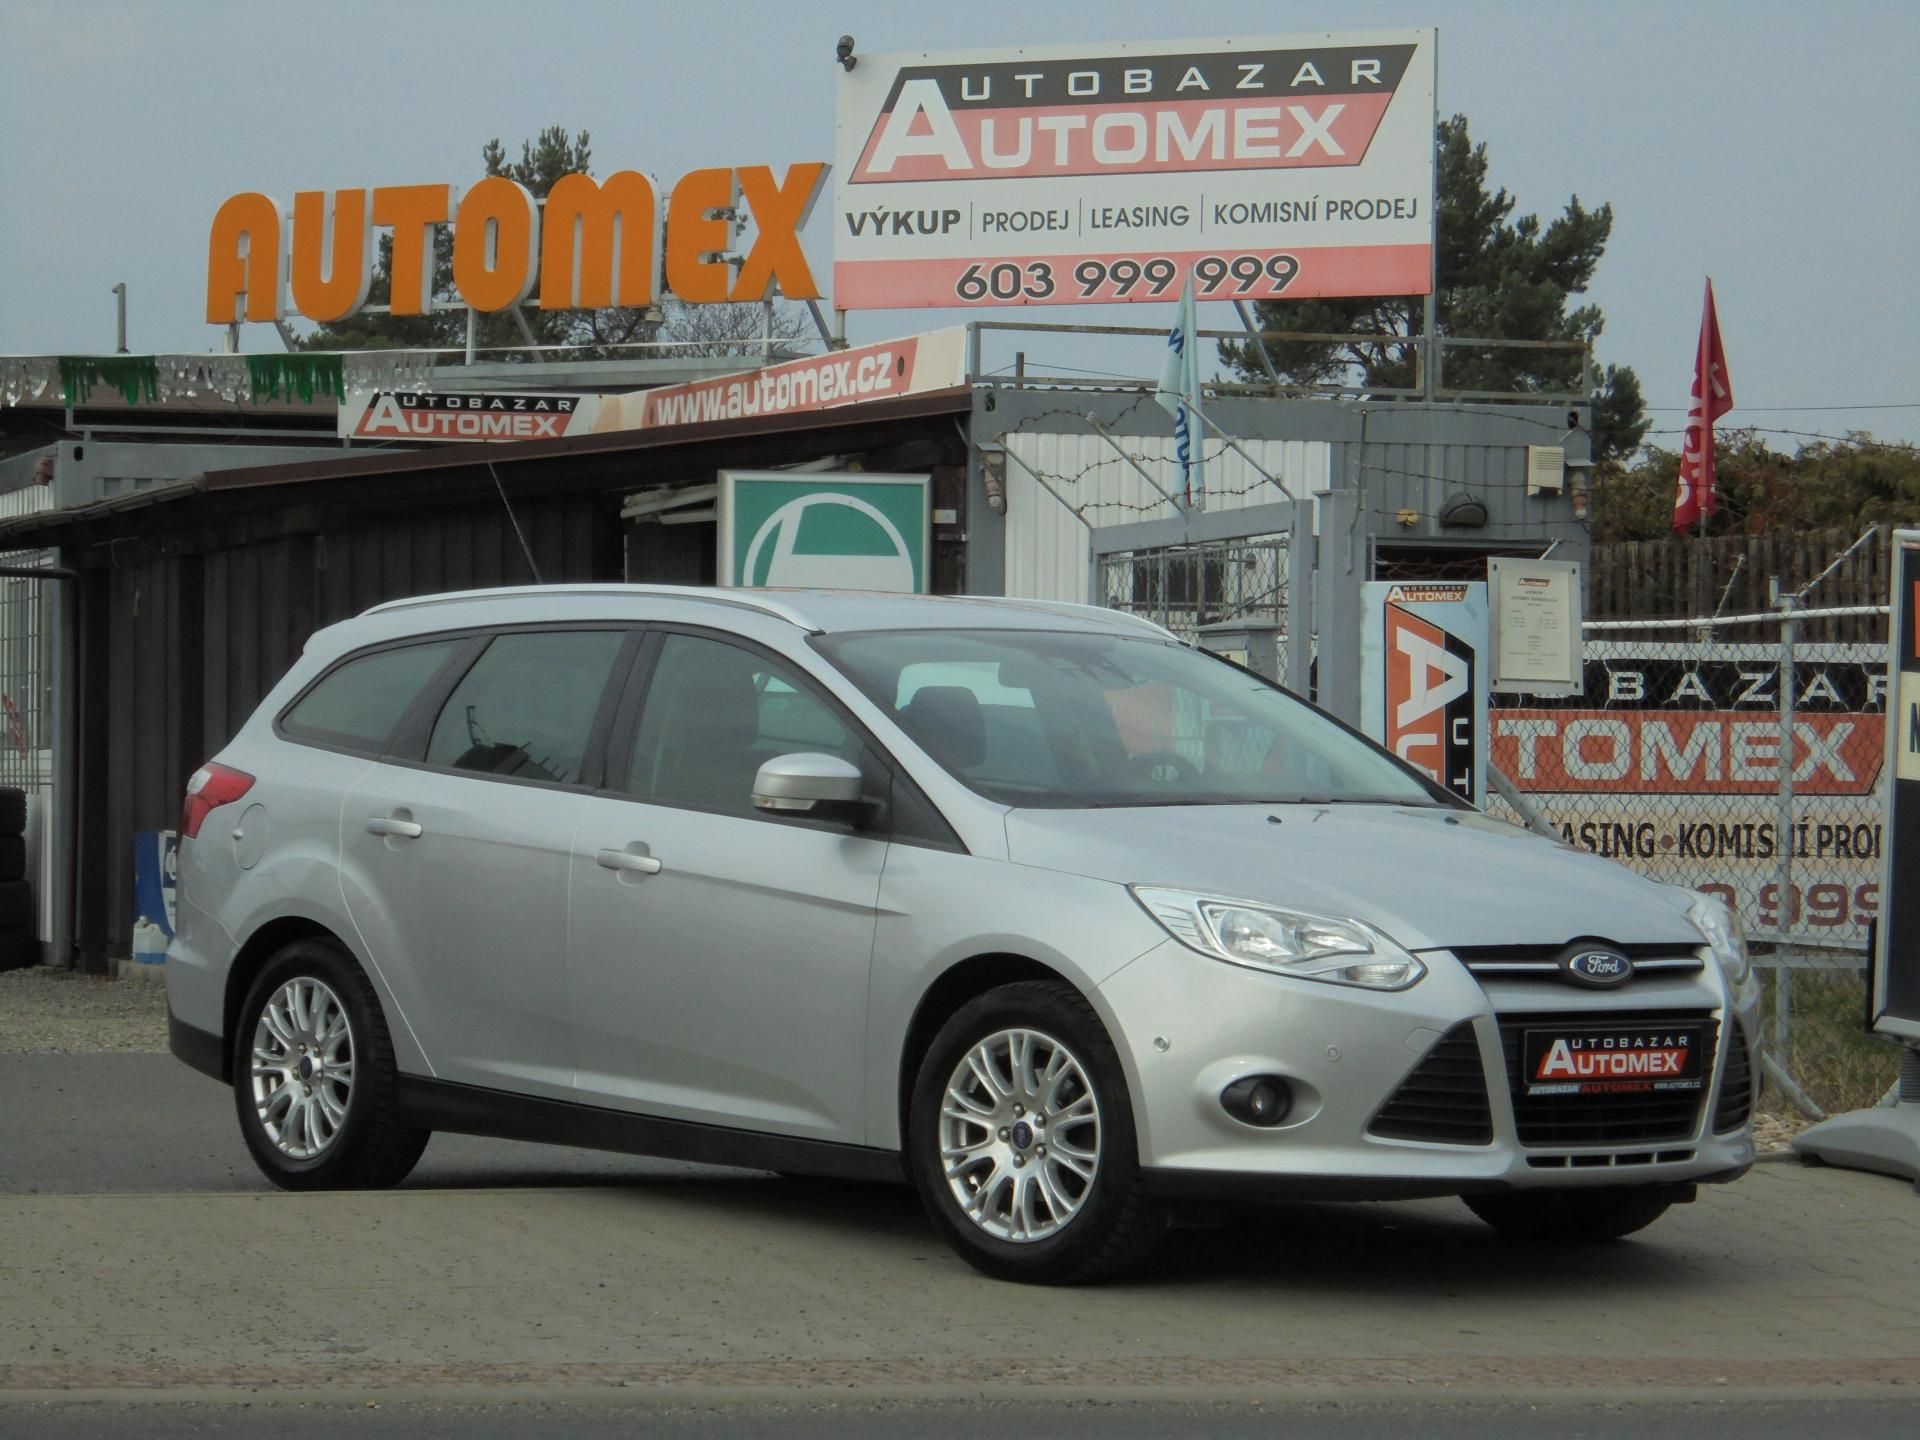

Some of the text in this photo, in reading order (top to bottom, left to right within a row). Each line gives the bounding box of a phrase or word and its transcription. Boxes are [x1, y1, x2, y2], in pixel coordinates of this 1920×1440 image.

[865, 79, 1347, 174] AUTOMEX
[845, 194, 1418, 237] VÝKUP PRODEJ LEASING KOMISNÍ PRODEJ
[206, 162, 832, 324] AUTOMEX
[955, 253, 1300, 301] 603 999 999
[656, 351, 893, 425] www.automex.cz
[363, 394, 558, 437] AUTOMEX
[1388, 586, 1462, 602] AUTOMEX
[1587, 955, 1620, 974] Ford
[1543, 1039, 1679, 1075] AUTOMEX
